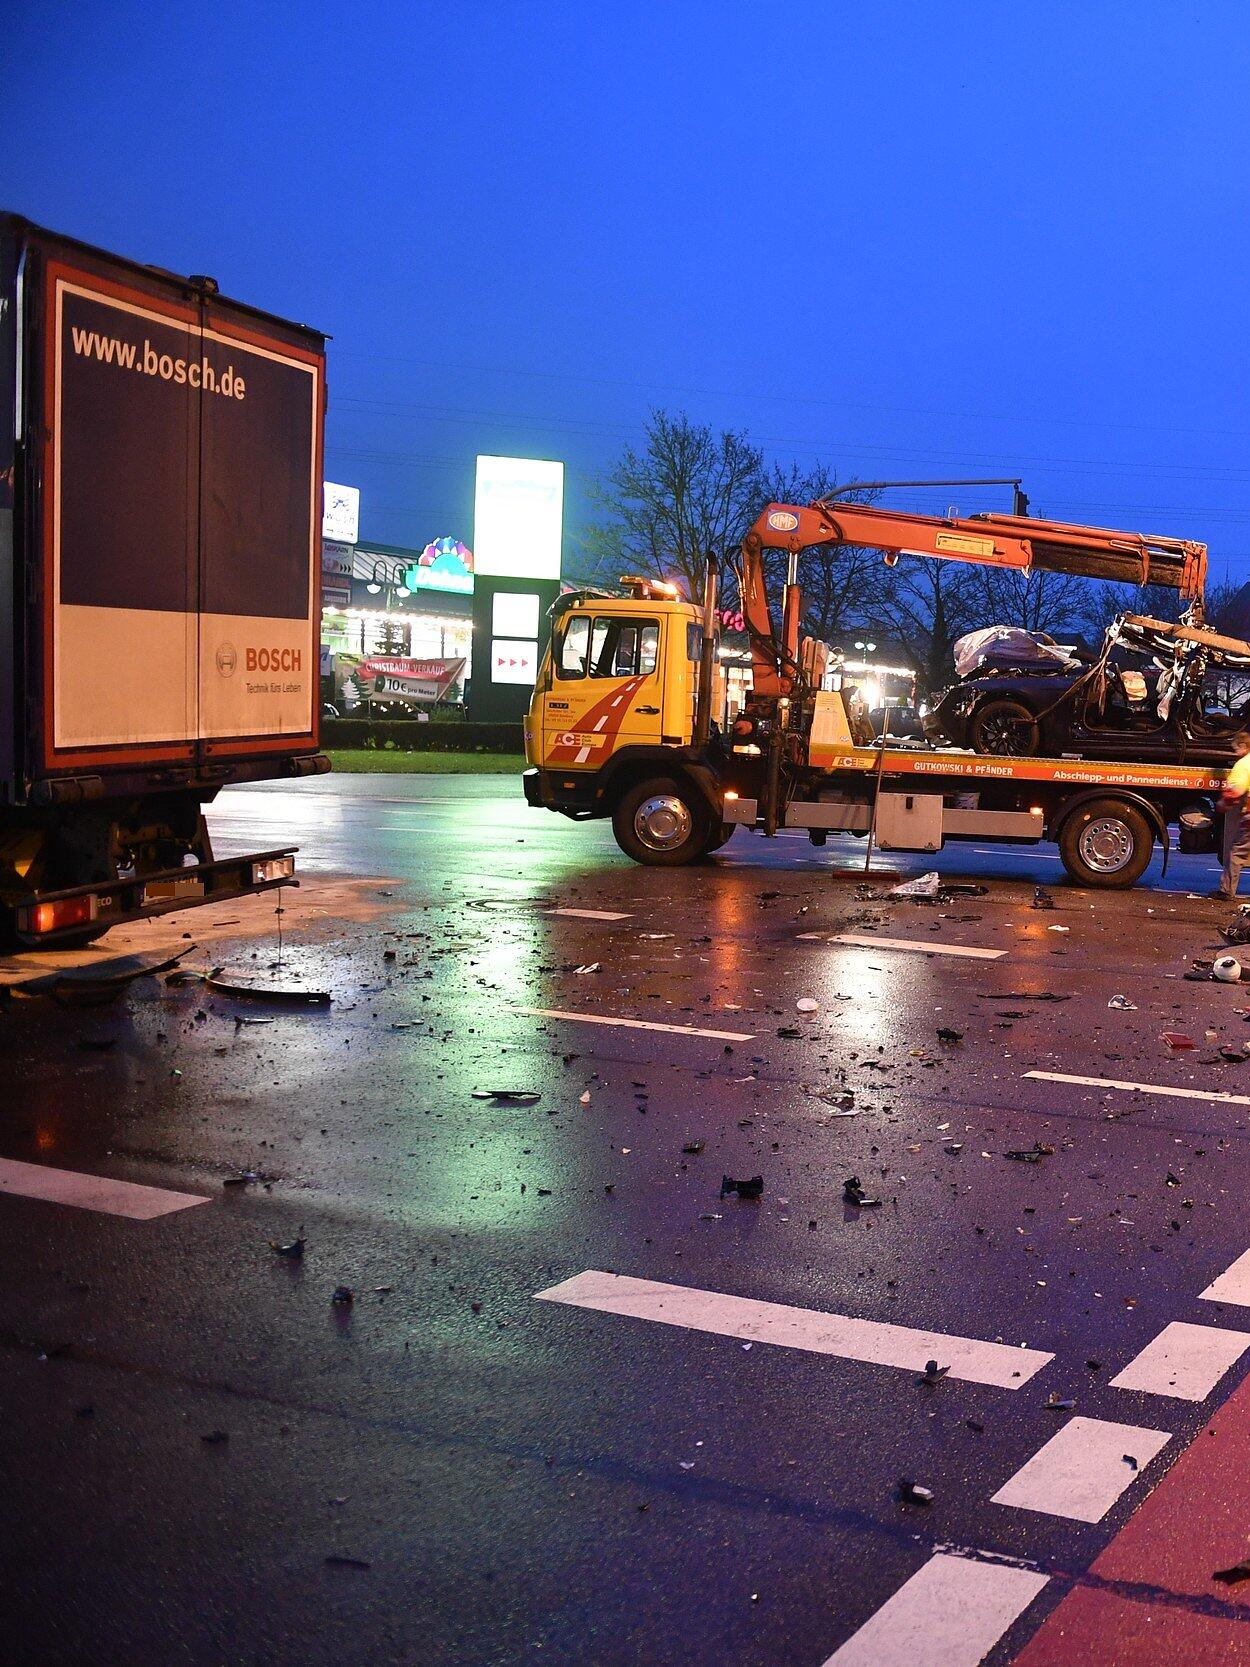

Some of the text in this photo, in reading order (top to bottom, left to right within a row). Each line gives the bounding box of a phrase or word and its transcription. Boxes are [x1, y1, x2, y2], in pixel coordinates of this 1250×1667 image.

[72, 326, 246, 400] www.bosch.de
[245, 647, 301, 672] BOSCH
[246, 682, 302, 693] Technik fürs Leben
[418, 687, 436, 696] Meter
[554, 733, 581, 746] ACE
[913, 761, 964, 773] GUTKOWSKI
[975, 765, 1014, 776] PFÄNDER
[1053, 770, 1106, 783] Abschlepp-
[1106, 774, 1125, 783] und
[1126, 775, 1189, 786] Pannendienst
